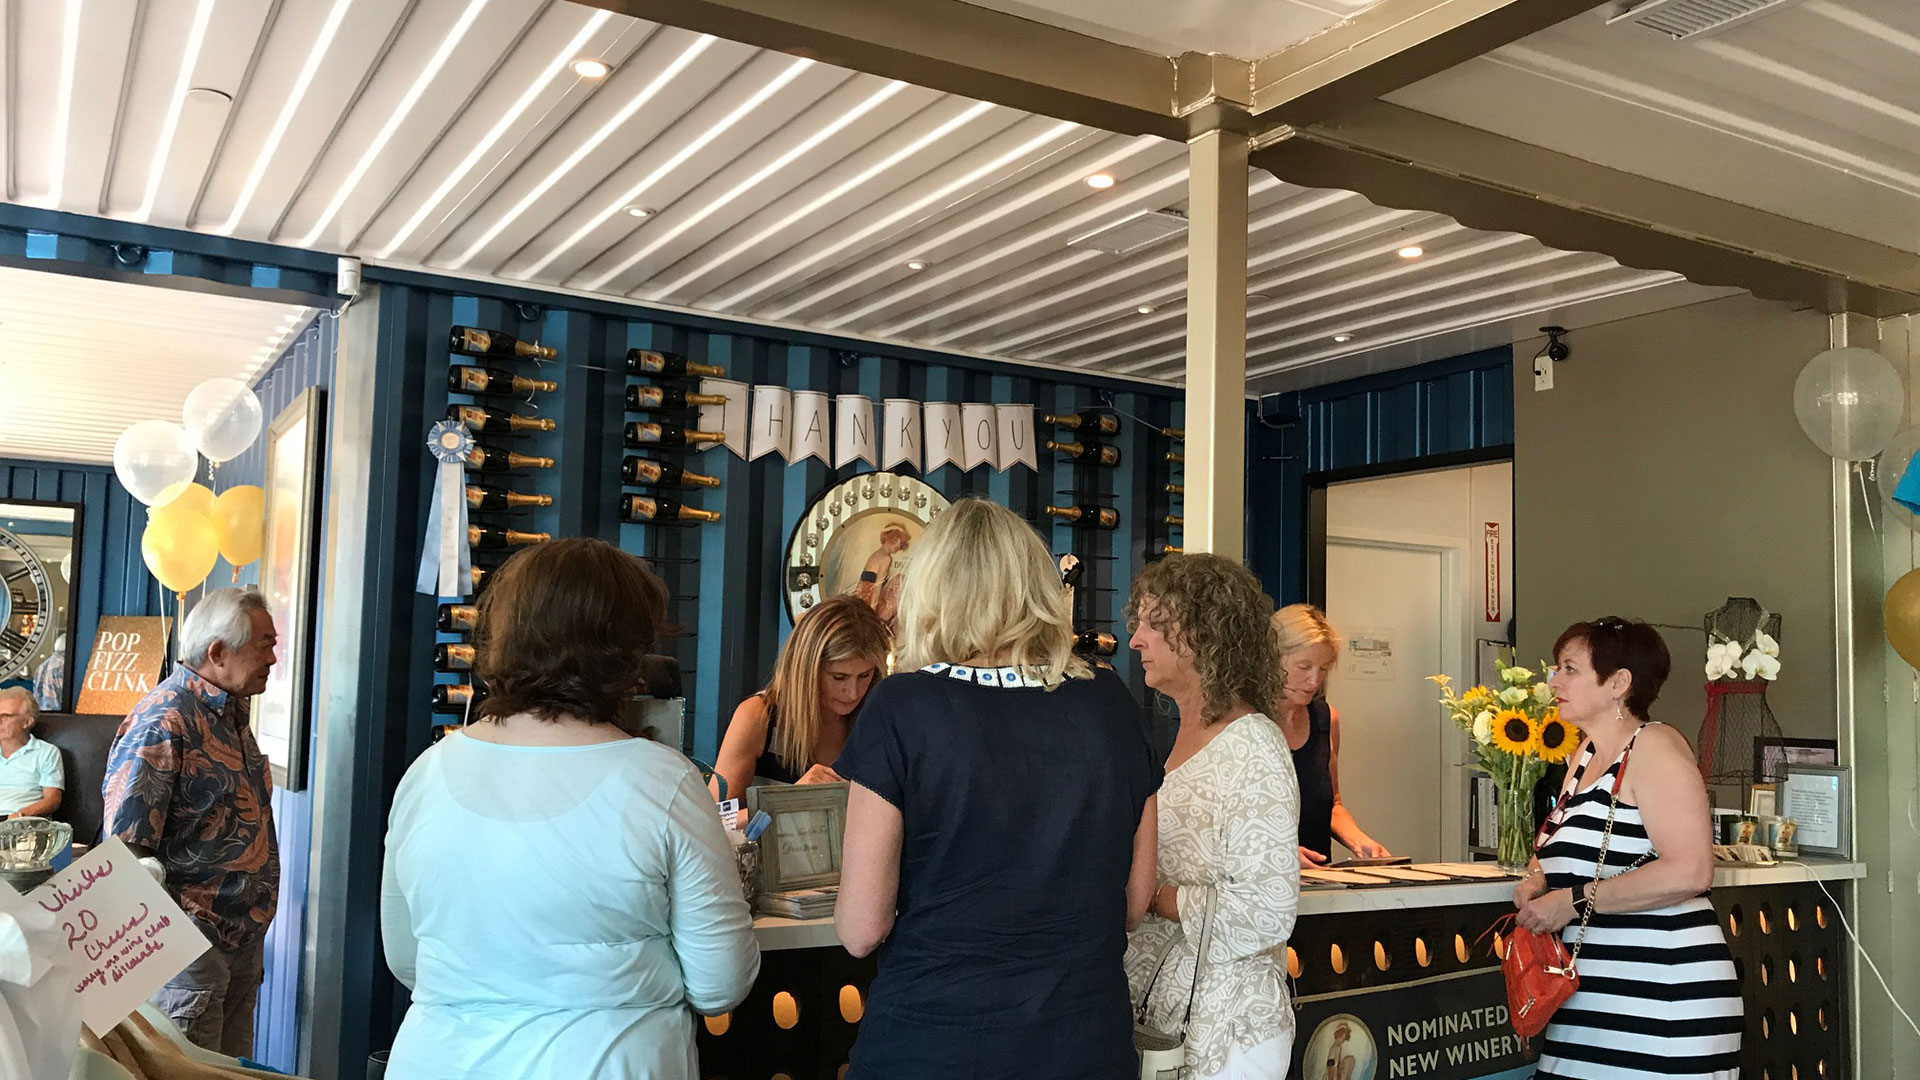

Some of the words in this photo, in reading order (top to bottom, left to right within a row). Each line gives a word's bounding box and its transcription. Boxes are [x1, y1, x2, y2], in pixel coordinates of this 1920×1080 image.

[941, 418, 1024, 451] YOU
[1486, 529, 1499, 538] FIRE
[97, 631, 141, 652] POP
[92, 651, 140, 672] FIZZ
[87, 671, 153, 693] CLINK
[62, 909, 98, 951] 20
[120, 936, 142, 956] wine
[1387, 1005, 1509, 1047] NOMINATED
[1389, 1049, 1439, 1080] NEW
